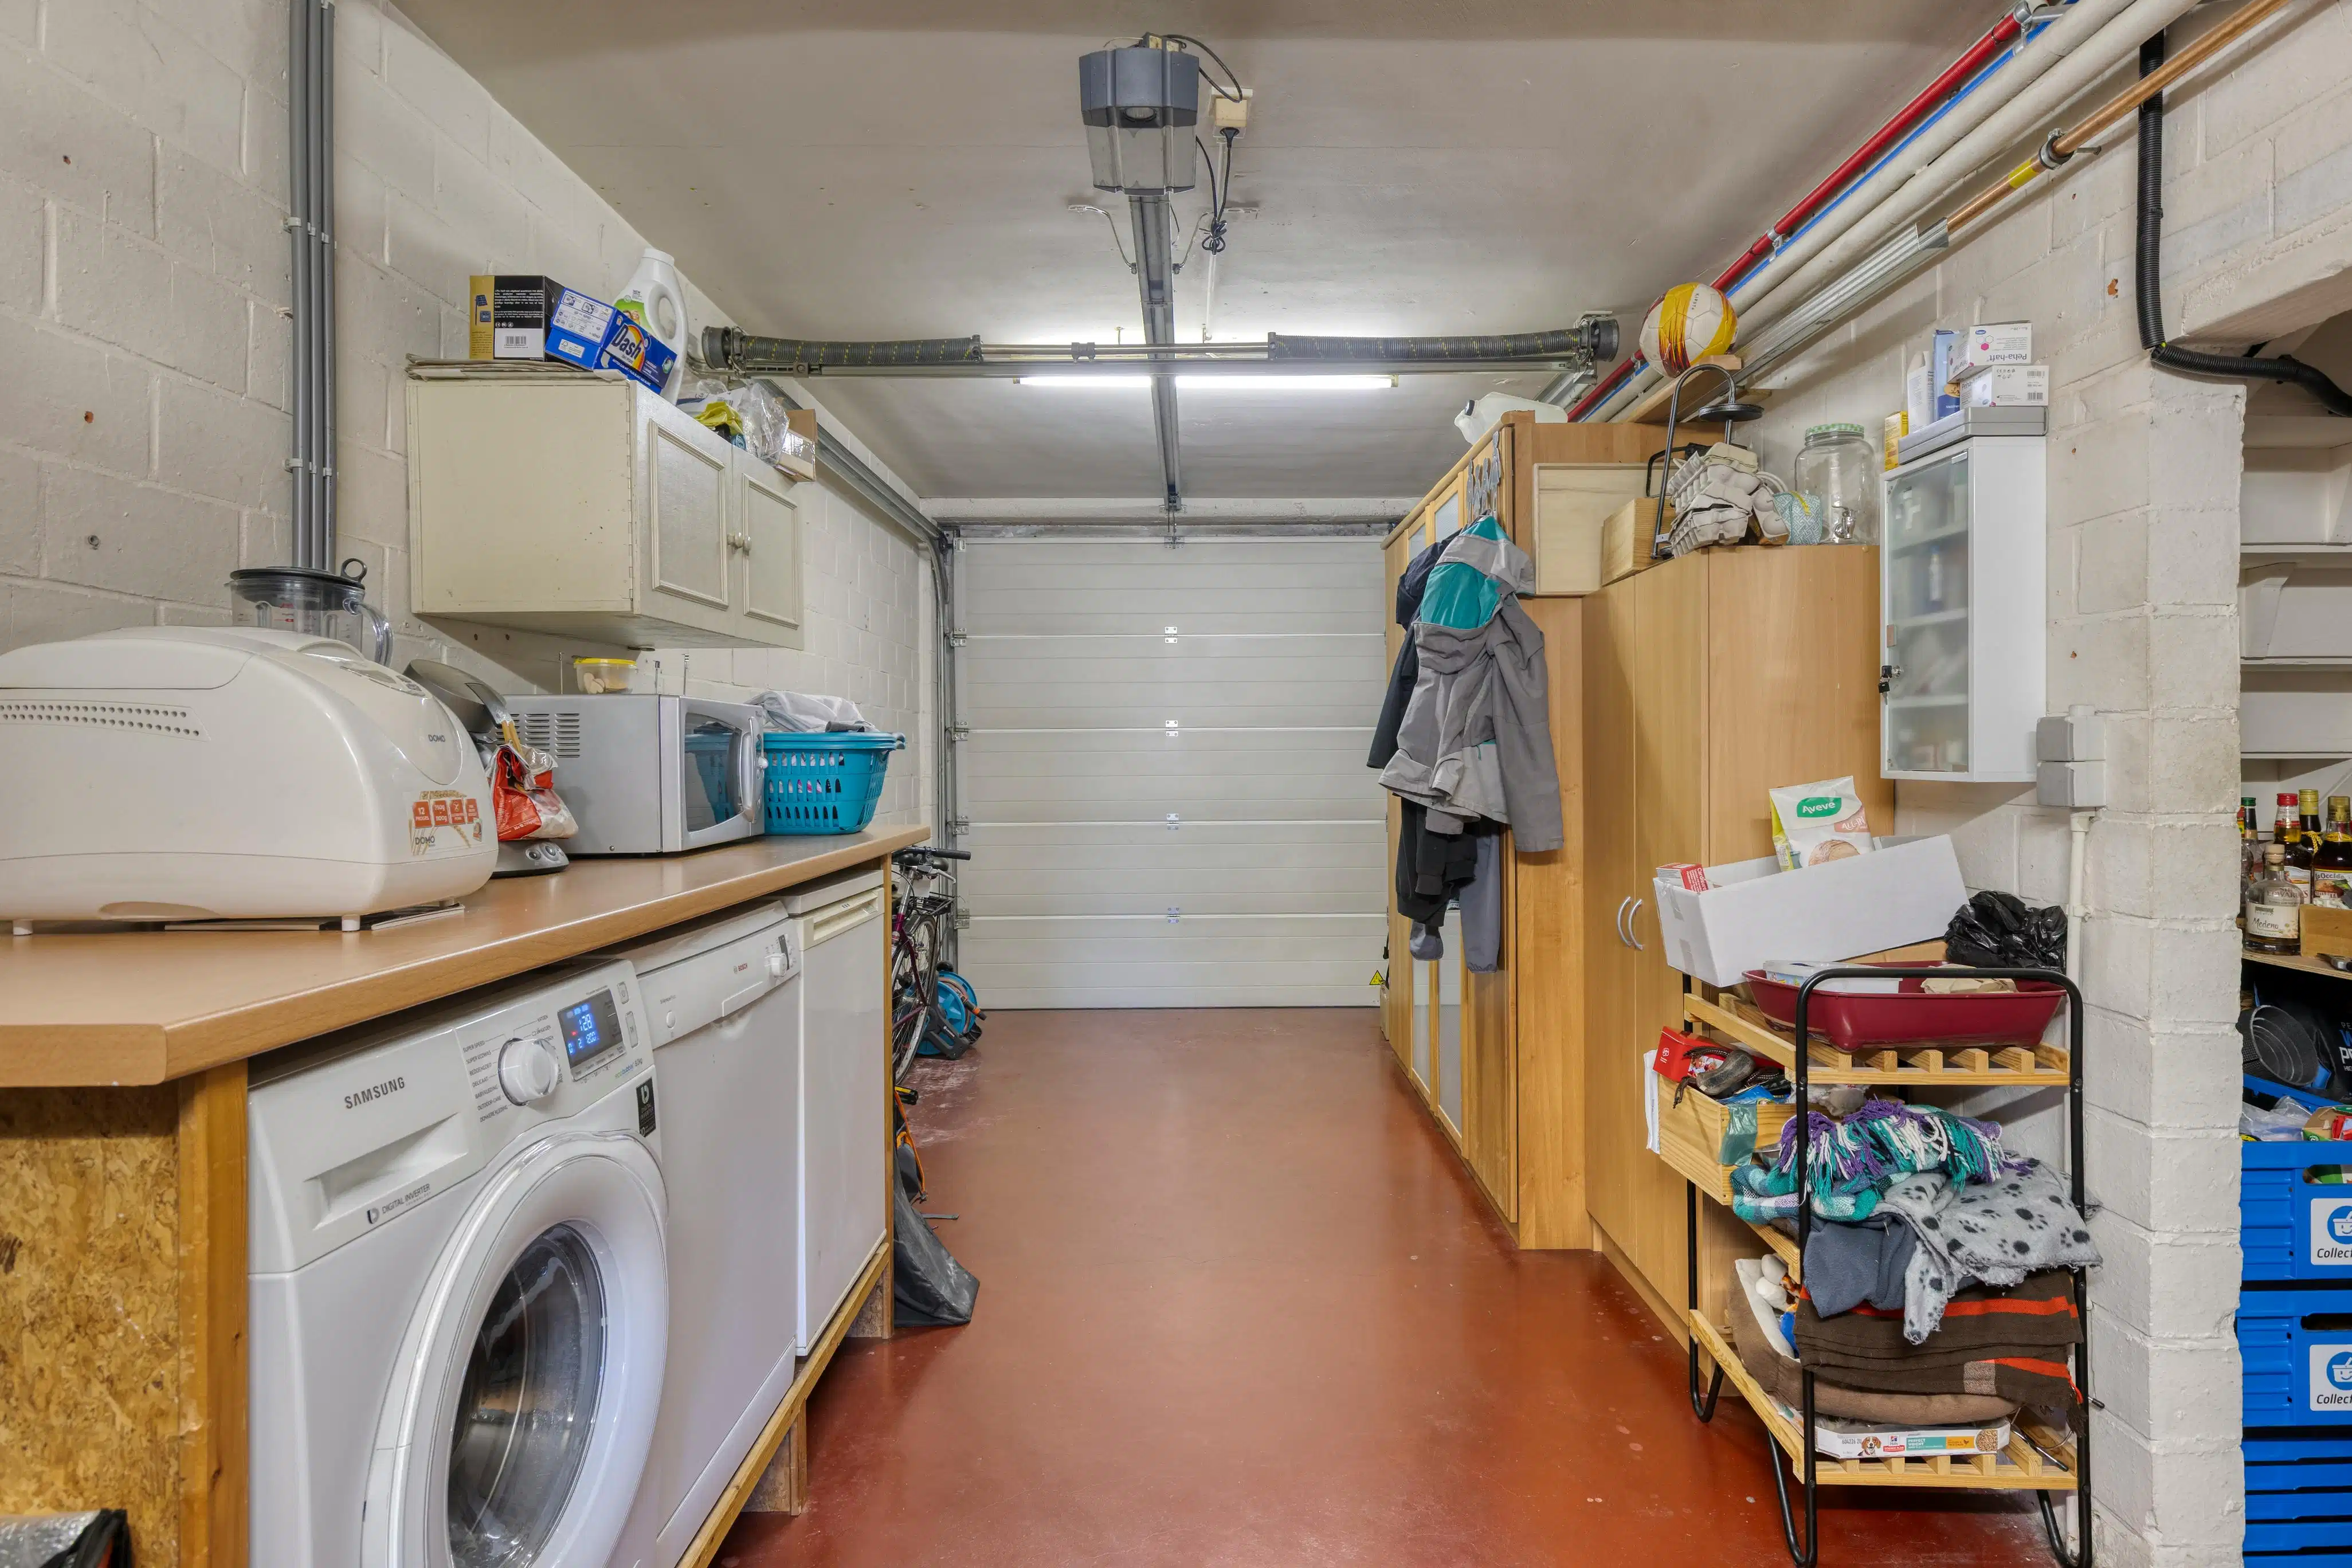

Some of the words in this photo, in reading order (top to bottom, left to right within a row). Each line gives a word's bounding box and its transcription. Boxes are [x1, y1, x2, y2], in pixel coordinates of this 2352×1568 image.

[611, 323, 642, 360] Dash
[1989, 353, 2027, 362] Peha-haft
[418, 807, 425, 816] 12
[1802, 802, 1836, 814] Aveve
[1841, 816, 1866, 830] ALL-IN
[414, 836, 435, 845] DOMO
[738, 963, 747, 972] BOSCH
[475, 1040, 485, 1049] SPEED
[466, 1056, 478, 1064] SUPER
[472, 1076, 489, 1088] DELICAAT
[344, 1077, 406, 1110] SAMSUNG
[480, 1111, 495, 1123] DONKERE
[495, 1104, 508, 1115] KLEDING
[382, 1196, 405, 1214] DIGITAL
[405, 1183, 430, 1202] INVERTER
